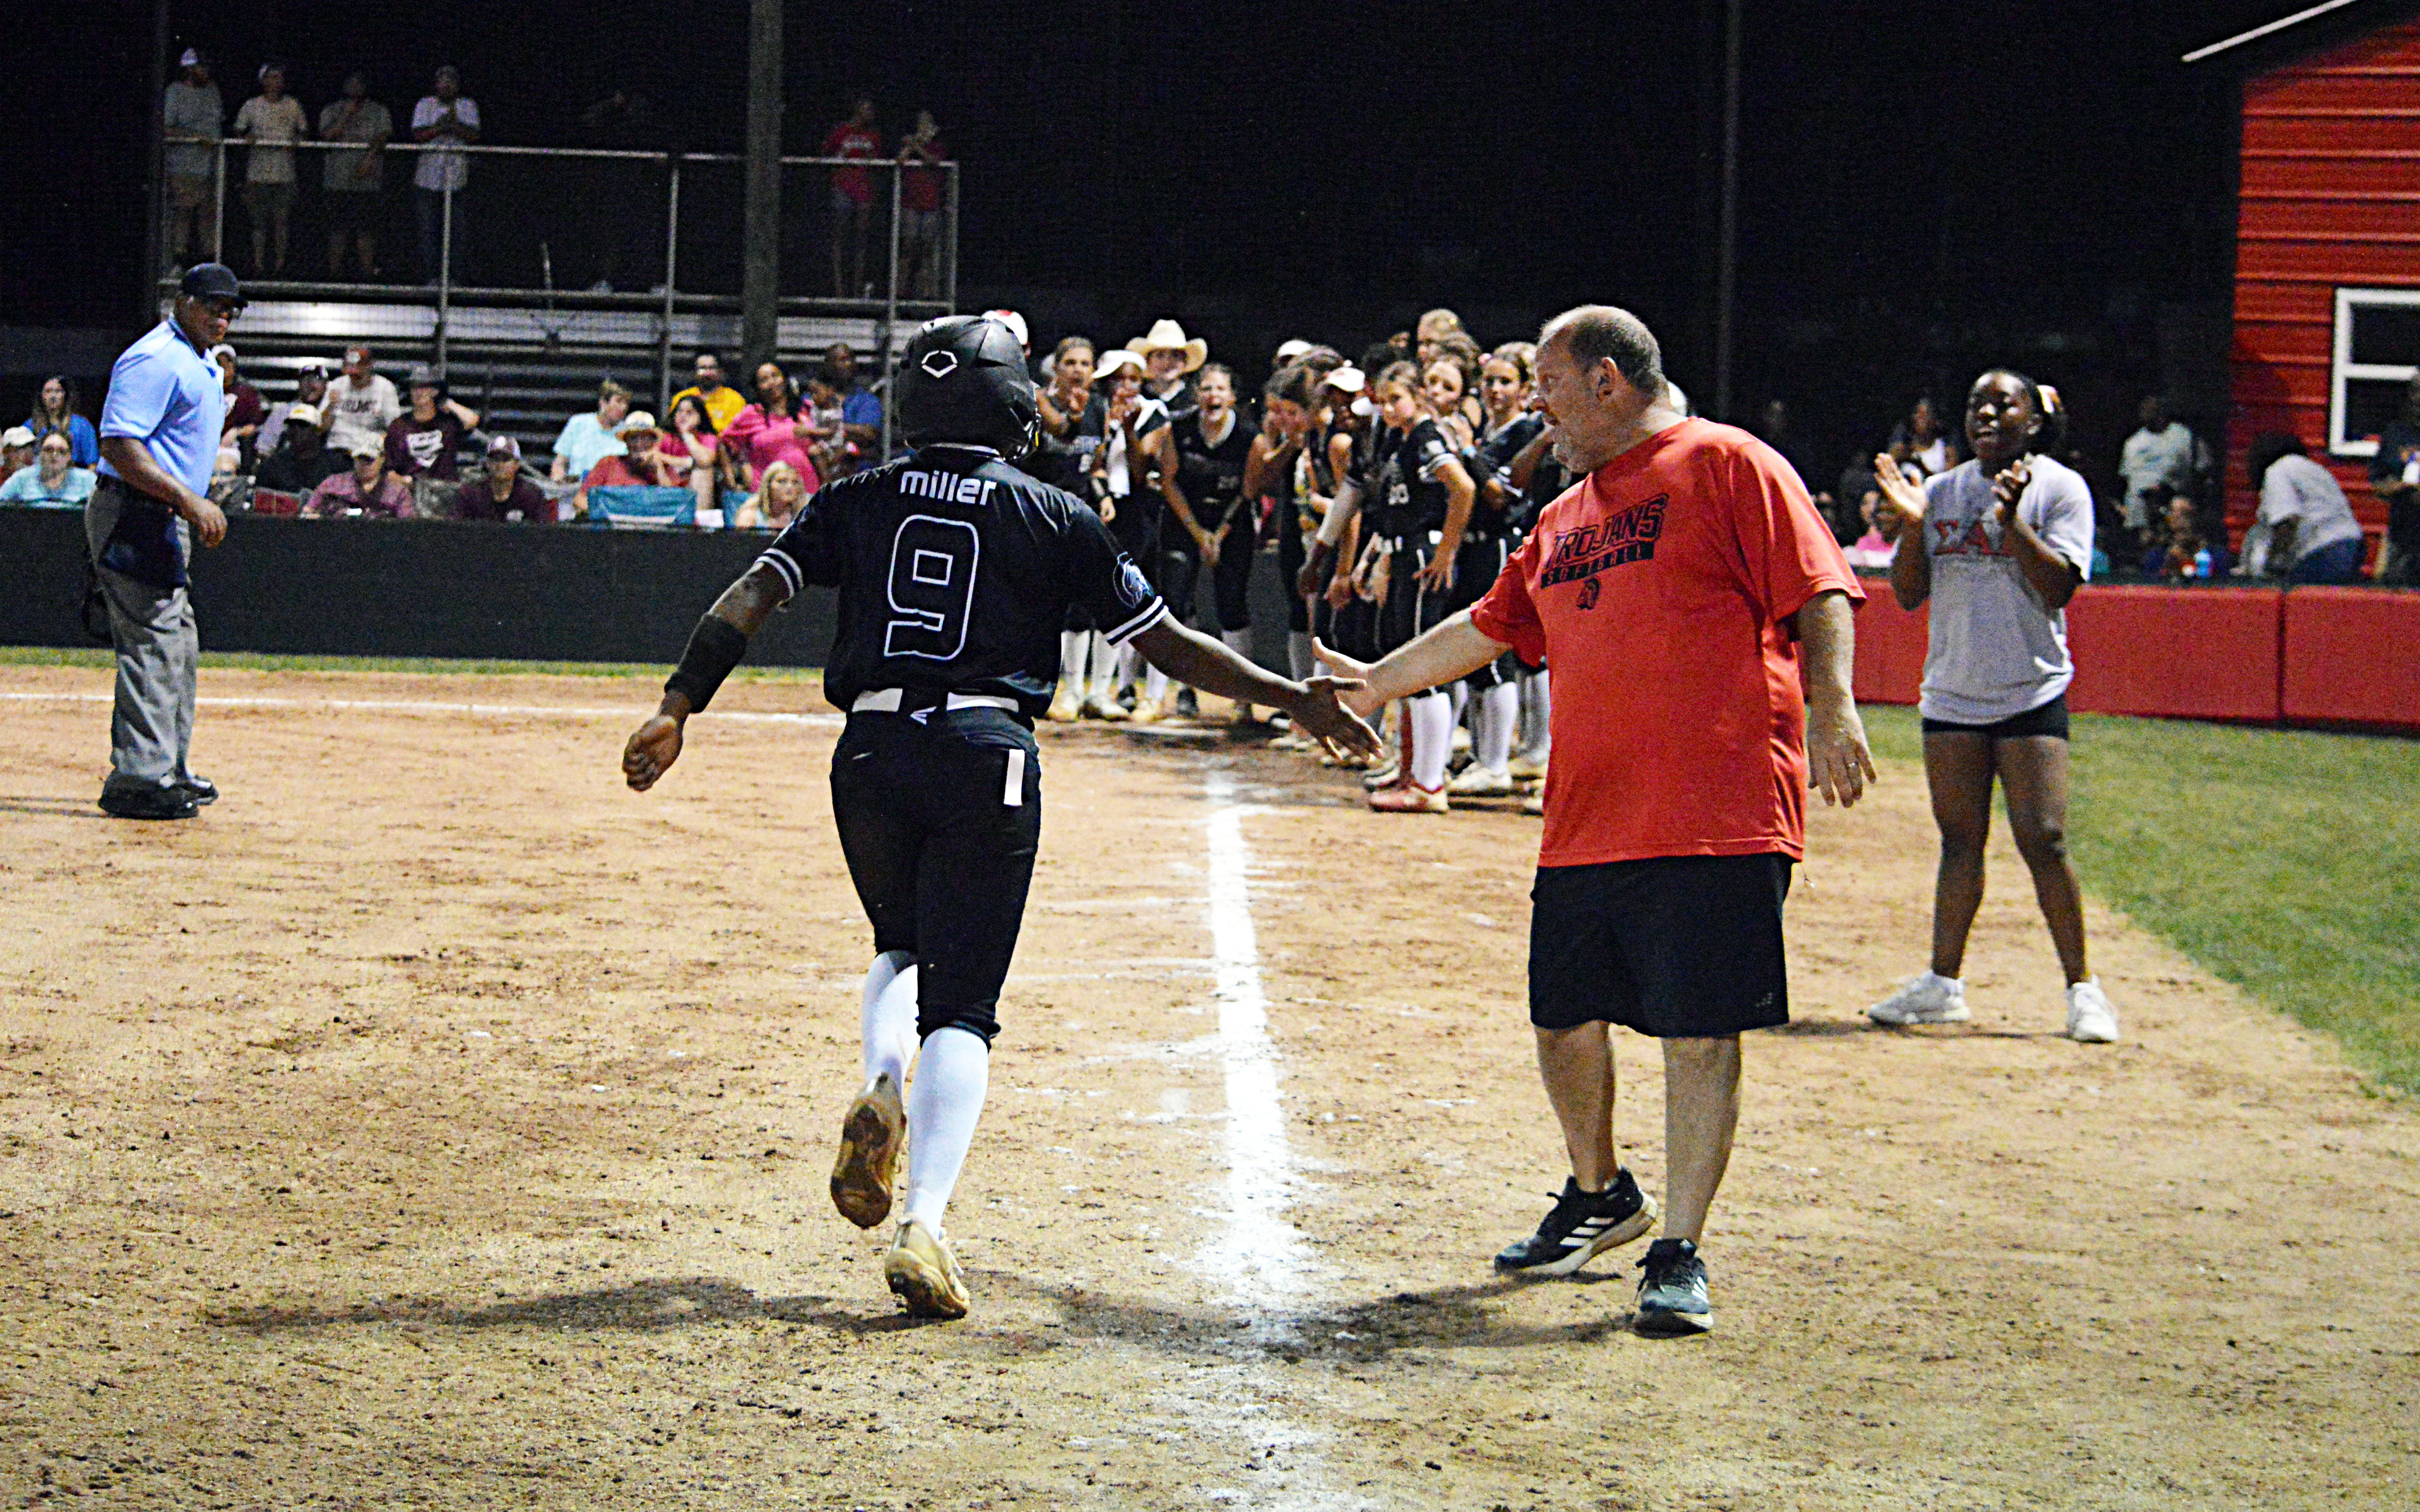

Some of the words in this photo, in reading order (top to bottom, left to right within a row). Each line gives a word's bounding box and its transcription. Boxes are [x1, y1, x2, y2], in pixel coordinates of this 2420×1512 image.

[900, 470, 997, 506] miller
[1546, 492, 1669, 569] TROJANS
[883, 514, 980, 661] 9
[1547, 543, 1643, 584] SOFTBALL
